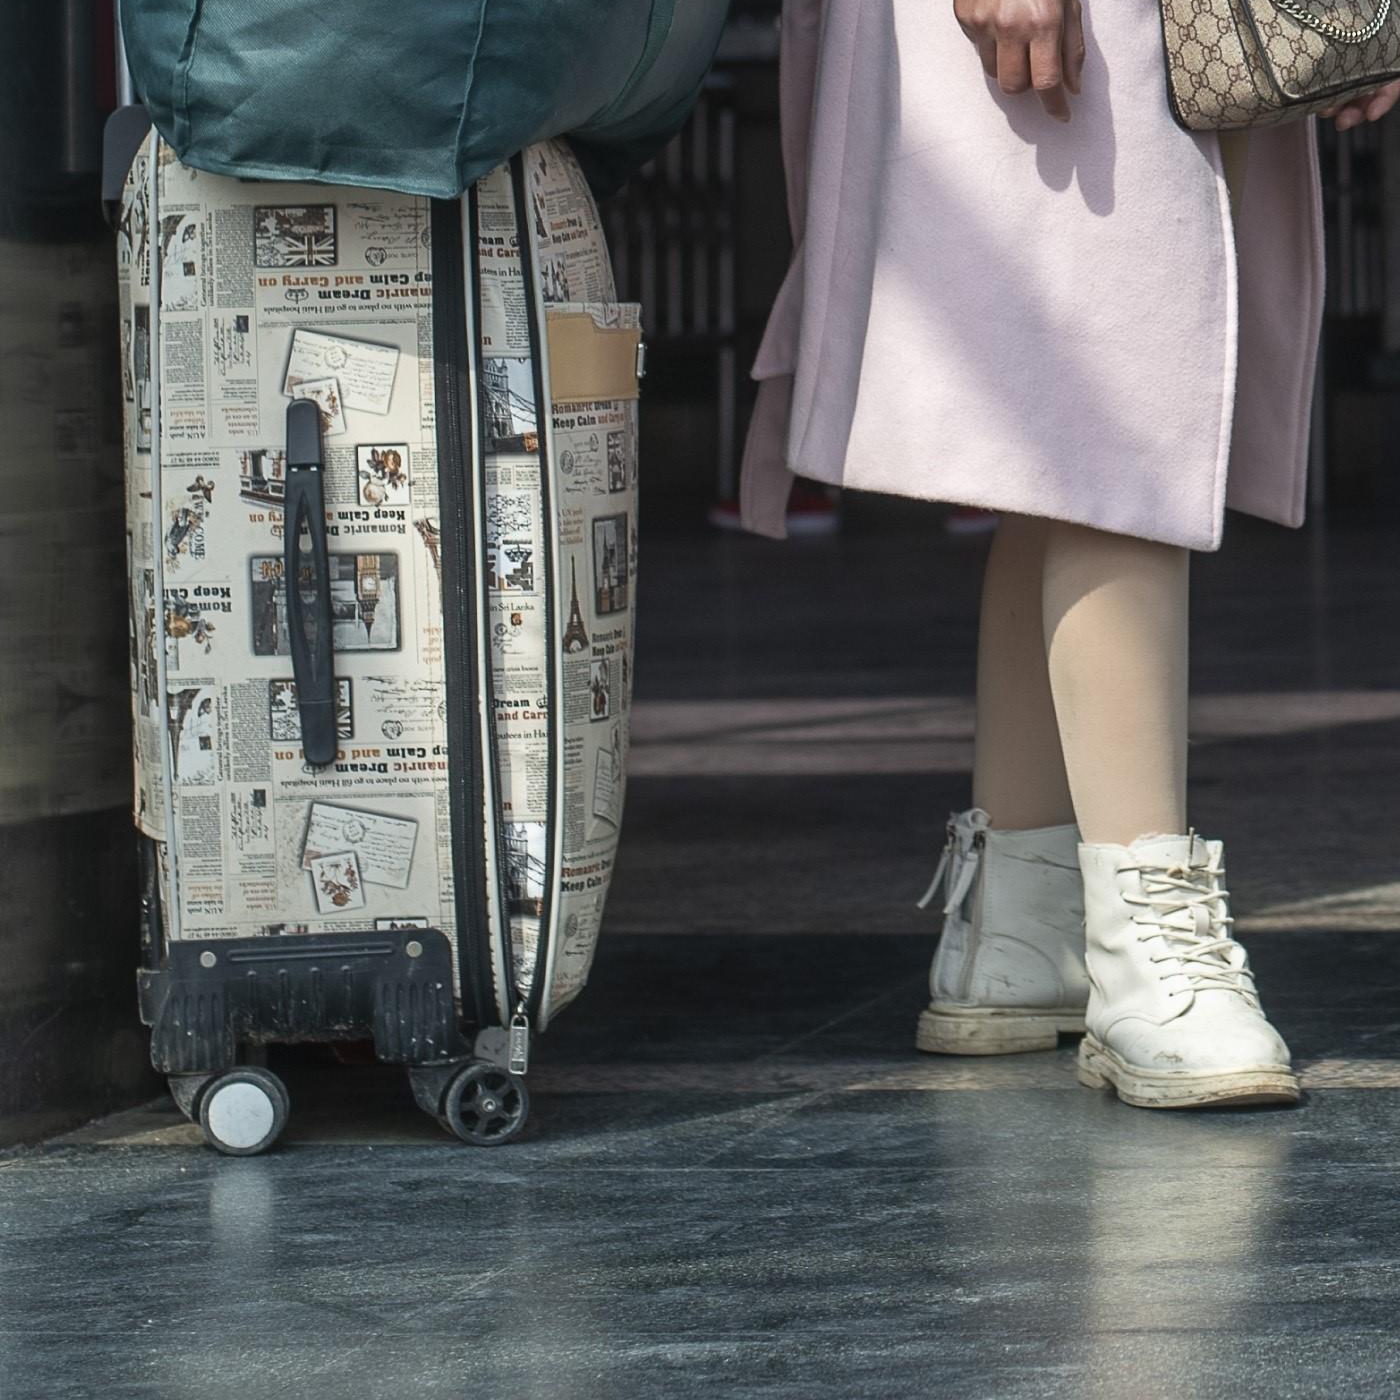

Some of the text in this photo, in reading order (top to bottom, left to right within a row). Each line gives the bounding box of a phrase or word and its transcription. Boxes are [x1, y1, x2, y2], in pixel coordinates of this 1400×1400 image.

[258, 278, 277, 289] on
[282, 275, 329, 288] Carry
[334, 276, 364, 287] and
[370, 274, 409, 285] Calm
[318, 290, 370, 300] Dream
[249, 513, 264, 524] on
[338, 510, 370, 522] Calm
[374, 509, 405, 521] Keep
[344, 524, 406, 536] Romanric
[193, 585, 231, 598] Keep
[510, 601, 534, 611] Lanka
[497, 711, 519, 720] and
[274, 752, 294, 761] on
[352, 749, 380, 760] and
[386, 748, 426, 758] Calm
[335, 763, 388, 774] Dream
[560, 877, 585, 892] Keep
